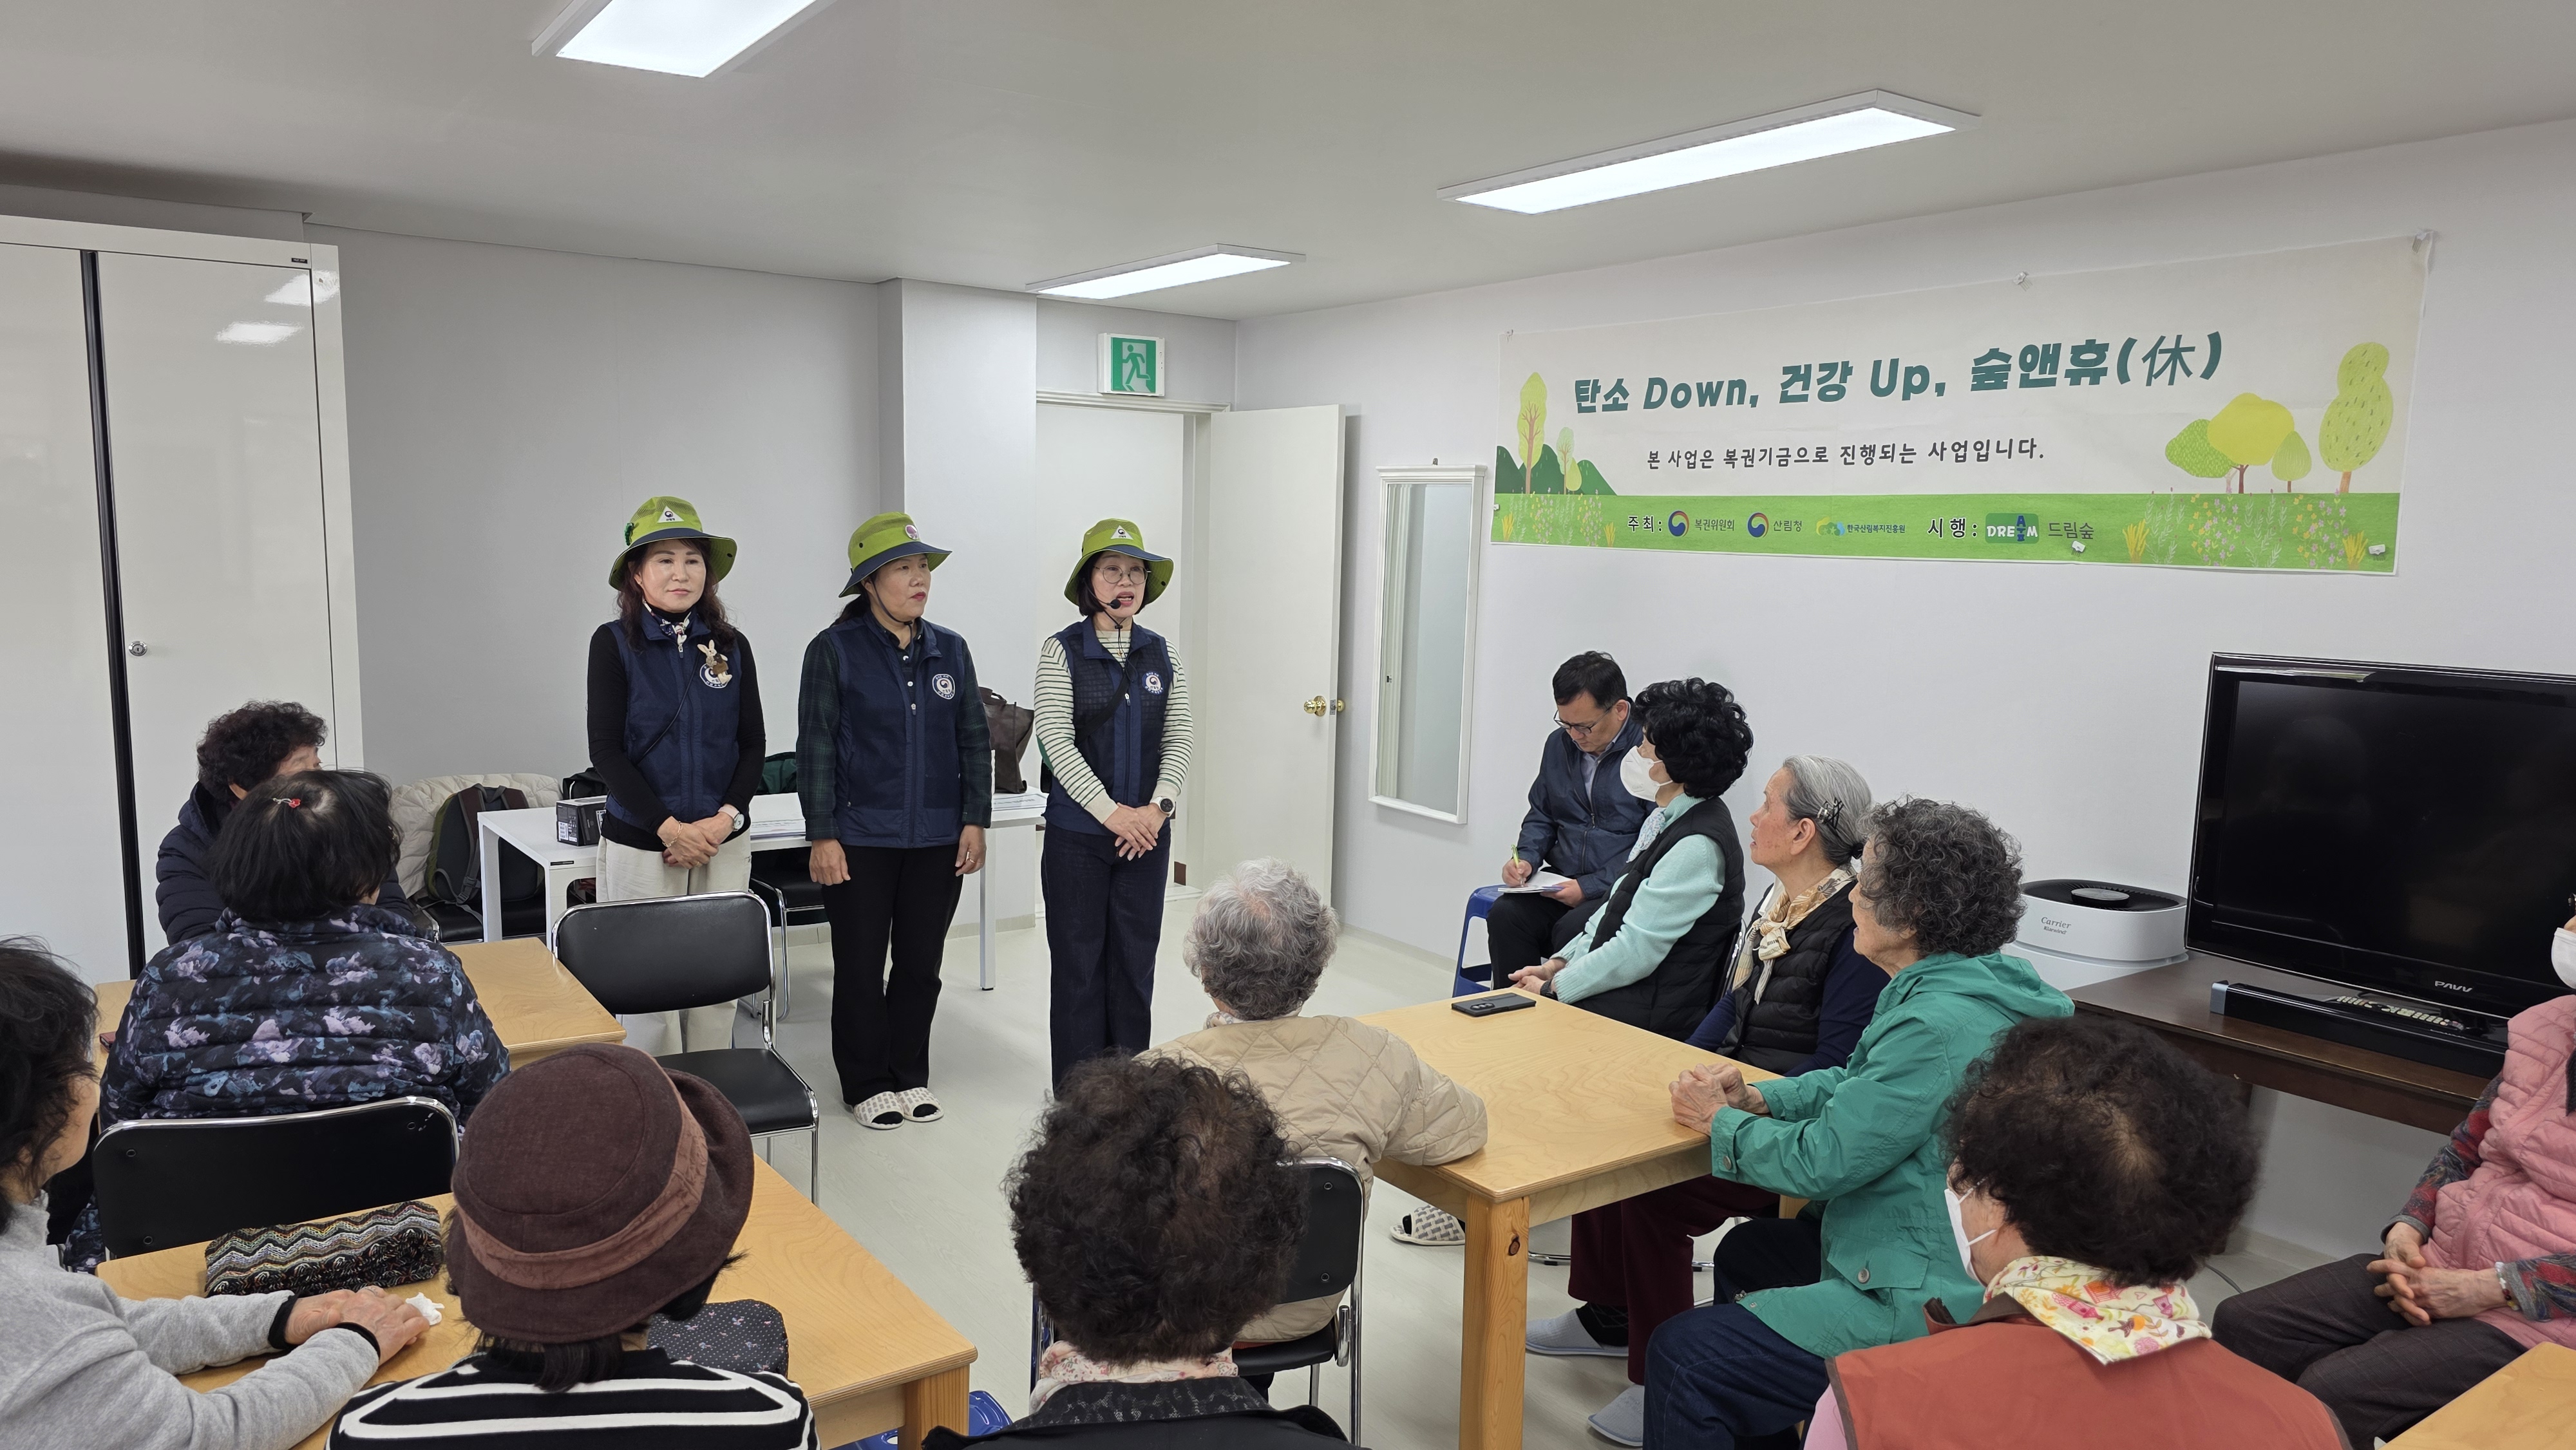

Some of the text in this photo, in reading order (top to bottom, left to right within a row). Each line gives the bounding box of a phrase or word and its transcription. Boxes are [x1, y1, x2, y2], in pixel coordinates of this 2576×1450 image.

[1575, 331, 2222, 413] 탄소 Down, 건강 Up, 숲앤휴(休)
[1647, 438, 2045, 469] 본 사업은 복권기금으로 진행되는 사업입니다.
[1694, 519, 1735, 531] 복권위원회
[1773, 520, 1803, 532] 산림청
[1847, 524, 1906, 534] 한국산림복지진흥원
[2048, 522, 2094, 540] 드림숲
[2041, 916, 2072, 928] Carrier
[2434, 980, 2473, 992] PAVV
